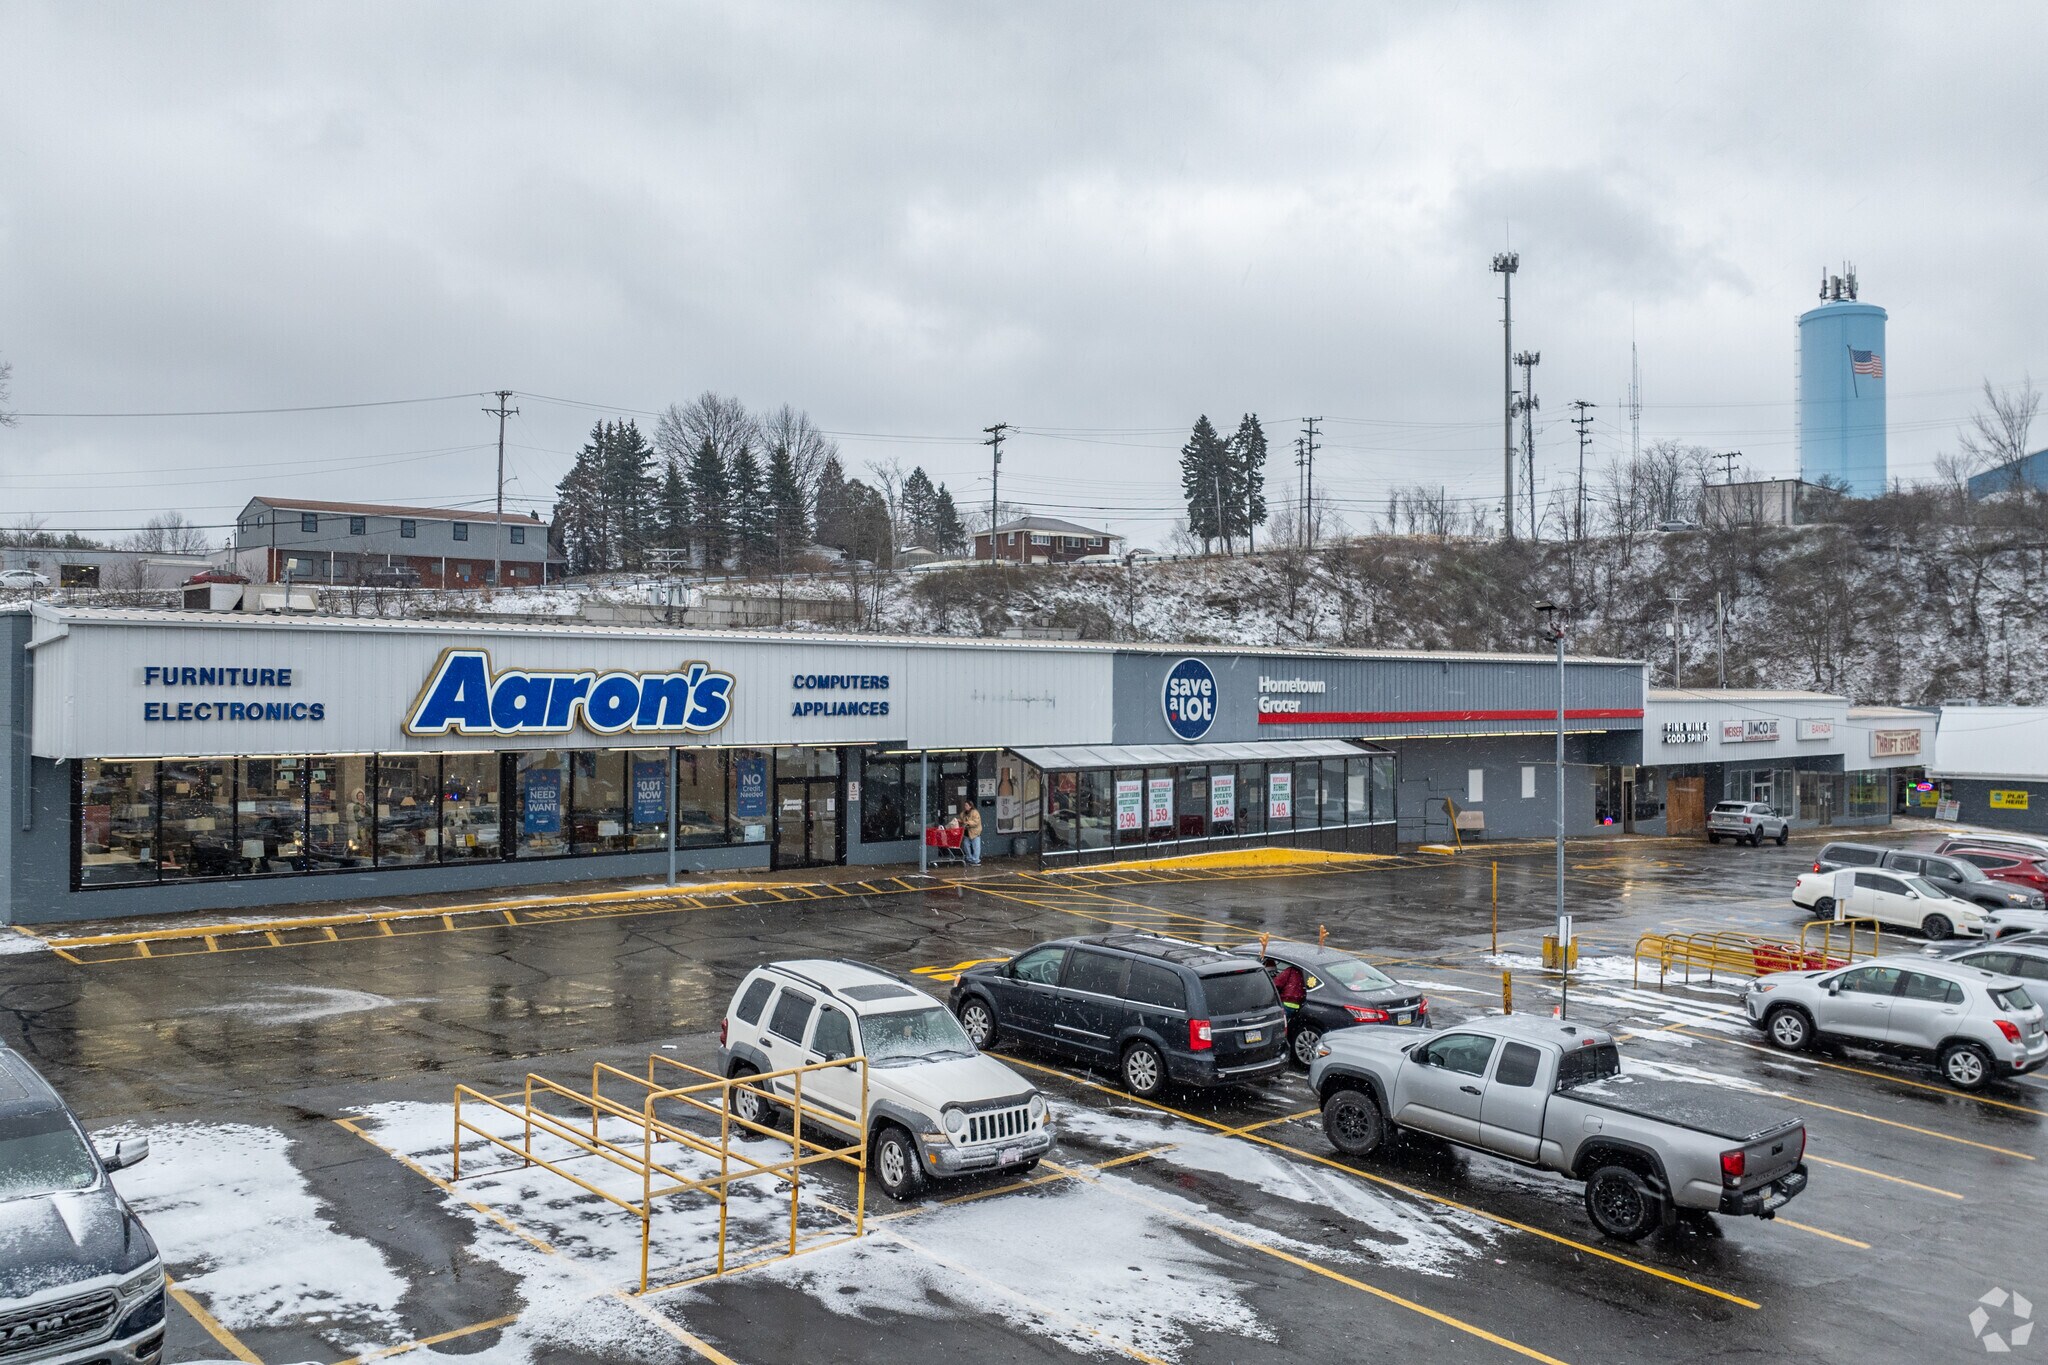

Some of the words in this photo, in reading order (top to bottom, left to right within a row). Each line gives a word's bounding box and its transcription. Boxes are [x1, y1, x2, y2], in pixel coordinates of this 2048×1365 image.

[144, 666, 292, 686] FURNITURE
[793, 674, 889, 689] COMPUTERS
[1170, 678, 1212, 696] save
[1258, 676, 1325, 693] Hometown
[408, 651, 733, 733] Aaron's
[144, 702, 325, 721] ELECTRONICS
[792, 701, 889, 716] APPLIANCES
[1258, 697, 1301, 713] Grocer
[1667, 722, 1684, 732] FINE
[1685, 722, 1703, 732] WINE
[1724, 726, 1742, 738] WEISER
[1748, 721, 1769, 735] JIMCO
[1667, 733, 1686, 743] GOOD
[1687, 732, 1710, 743] SPIRITS
[1876, 734, 1898, 753] THRIFT
[1900, 732, 1919, 752] STORE
[637, 780, 661, 791] $0.01
[742, 774, 762, 785] NO
[530, 790, 556, 799] NEED
[638, 791, 662, 800] NOW
[529, 803, 557, 812] WANT
[1213, 806, 1230, 818] 49¢
[1119, 813, 1136, 828] 2.99
[1149, 808, 1168, 822] 1.59
